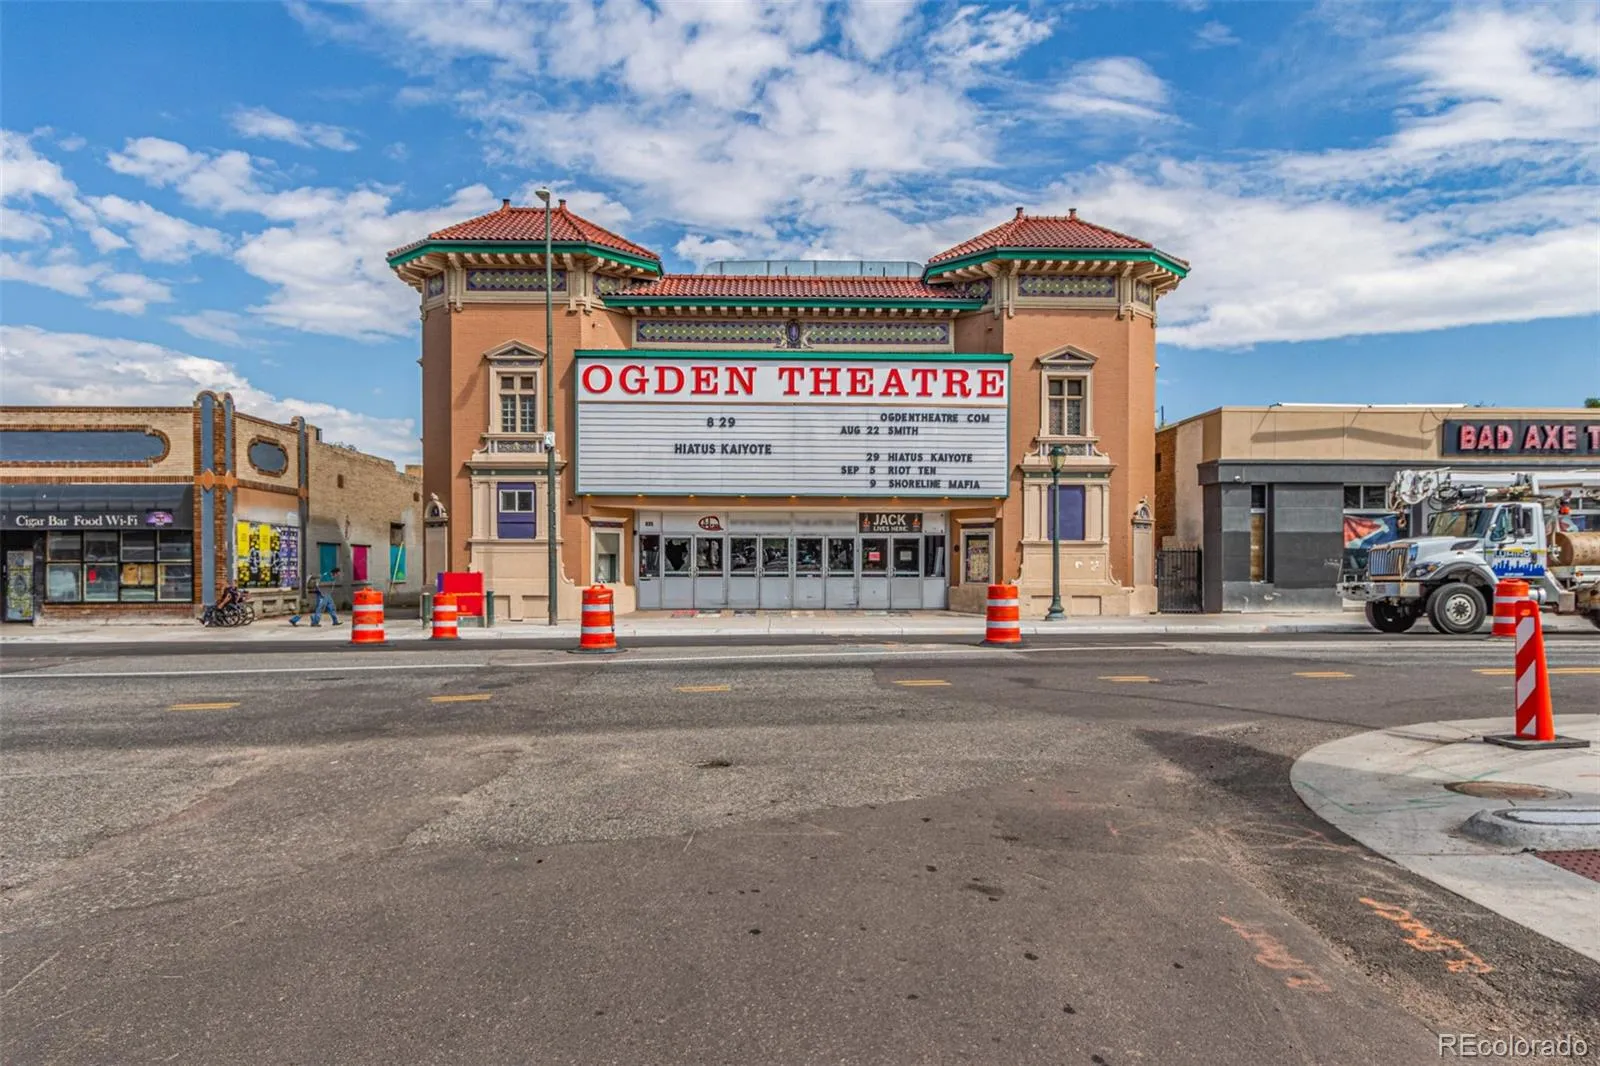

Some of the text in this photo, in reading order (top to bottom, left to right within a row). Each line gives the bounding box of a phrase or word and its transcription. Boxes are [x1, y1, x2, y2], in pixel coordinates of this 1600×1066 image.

[582, 364, 1005, 398] OGDEN THEATRE
[706, 416, 736, 428] 8 29
[880, 412, 990, 423] OGDENTHEATRE COM
[839, 425, 919, 436] AUG 22 SMITH
[1459, 424, 1600, 450] BAD AXE T
[674, 443, 772, 455] HIATUS KAIYOTE
[865, 452, 973, 463] 29 HIATUS KAIYOTE
[840, 465, 937, 476] SEP 5 RIOT TEN
[869, 479, 981, 490] 9 SHORELINE MAFIA
[15, 514, 138, 528] Cigar Bar Food Wi-Fi
[873, 514, 906, 526] JACK
